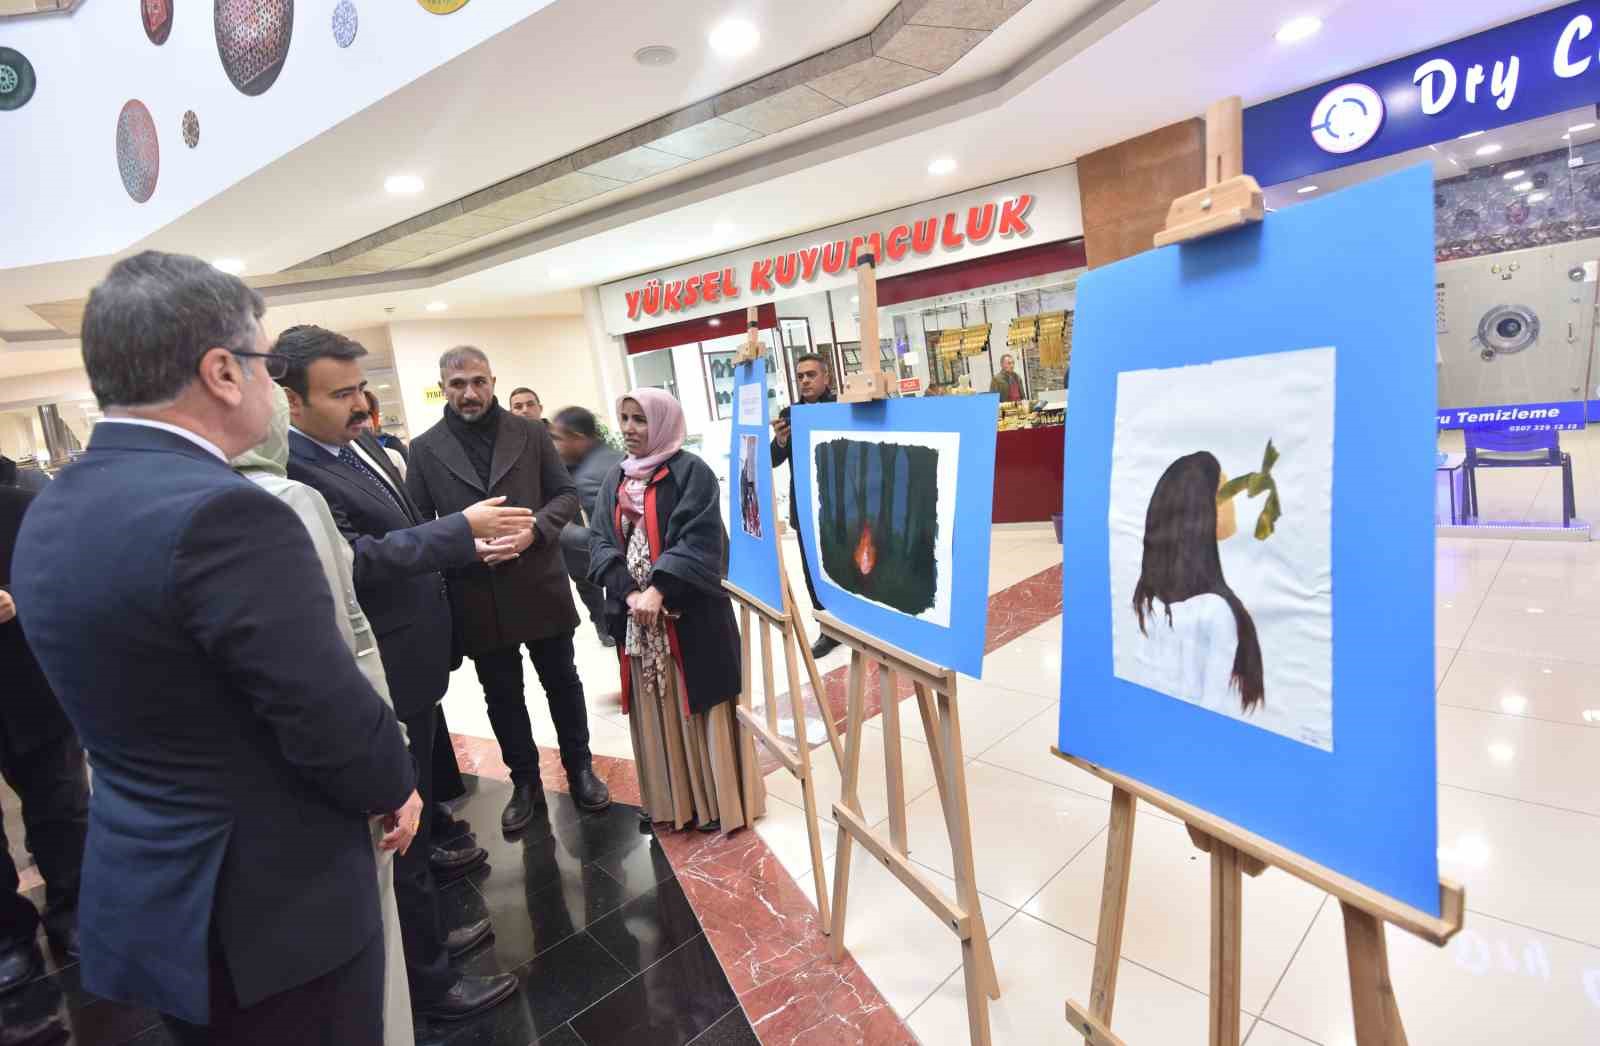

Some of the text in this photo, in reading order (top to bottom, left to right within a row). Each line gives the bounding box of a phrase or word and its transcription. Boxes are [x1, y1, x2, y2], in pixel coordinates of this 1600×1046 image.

[1412, 14, 1600, 116] Dry C
[624, 194, 1034, 320] YÜKSEL KUYUMCULUK
[1457, 408, 1560, 423] Temizleme
